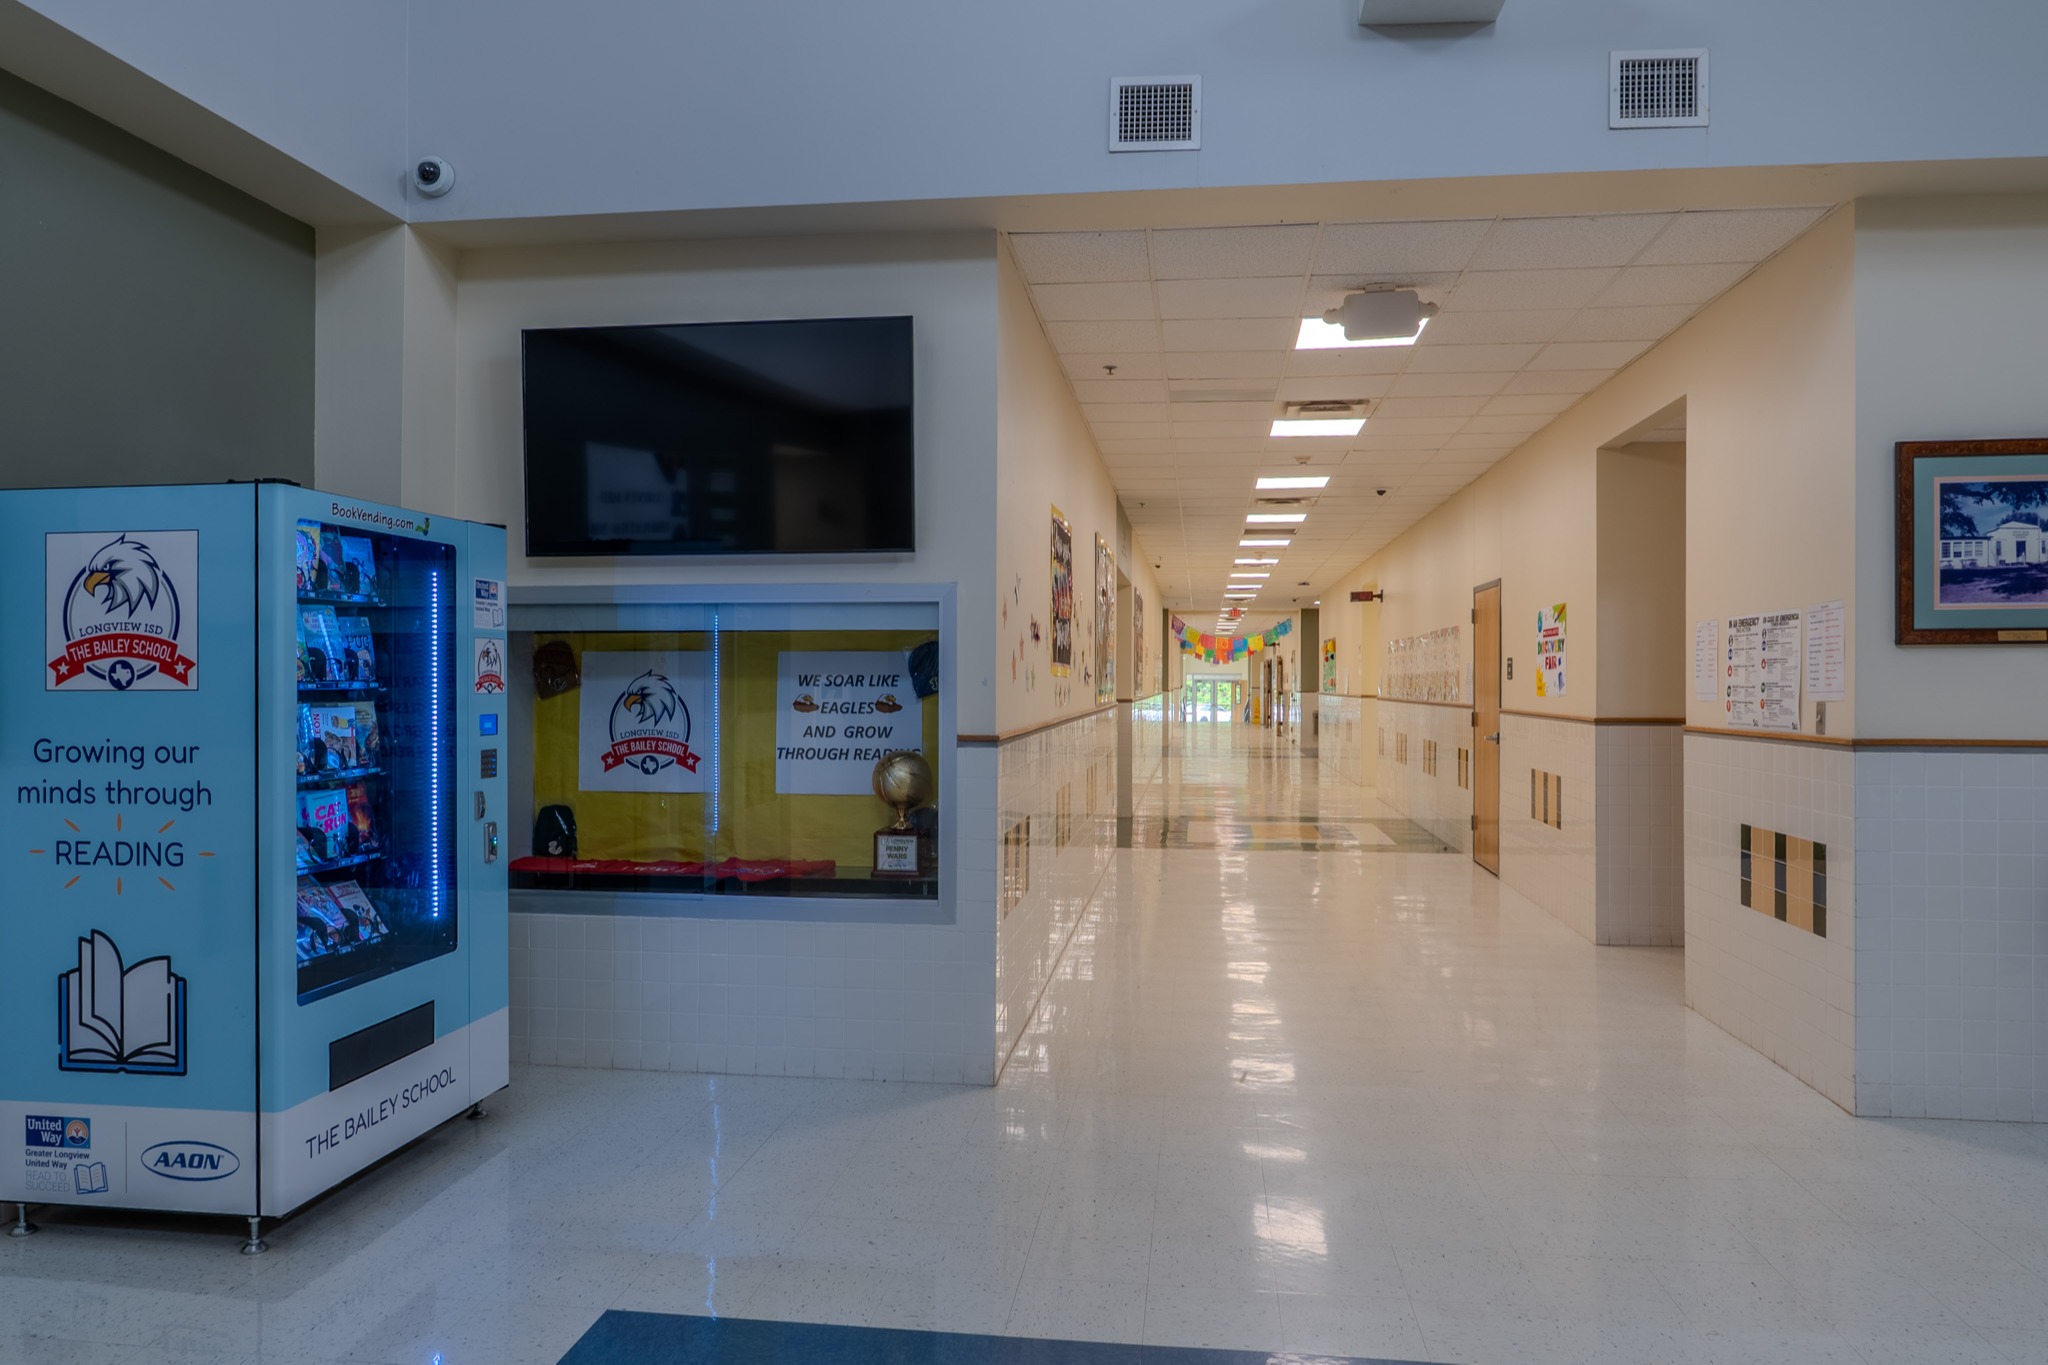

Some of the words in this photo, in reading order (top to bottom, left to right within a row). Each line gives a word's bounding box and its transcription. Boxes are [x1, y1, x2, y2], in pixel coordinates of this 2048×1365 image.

[332, 503, 414, 530] BookVending.com
[1738, 616, 1760, 628] EMERGENCY
[79, 622, 142, 638] LONGVIEW
[144, 624, 164, 636] ISD
[70, 644, 91, 662] THE
[93, 638, 130, 655] BAILEY
[132, 639, 173, 662] SCHOOL
[1545, 656, 1557, 670] FAIR
[798, 674, 822, 687] WE
[824, 674, 865, 687] SOAR
[868, 674, 900, 687] LIKE
[820, 702, 875, 714] EAGLES
[620, 729, 664, 739] LONGVIEW
[666, 731, 680, 739] ISD
[802, 726, 836, 738] AND
[844, 726, 894, 738] GROW
[33, 738, 145, 770] Growing
[154, 745, 200, 764] our
[614, 744, 630, 756] THE
[630, 740, 656, 752] BAILEY
[658, 741, 685, 756] SCHOOL
[776, 747, 849, 760] THROUGH
[18, 779, 96, 804] minds
[105, 780, 212, 812] through
[324, 812, 347, 834] RUN
[56, 840, 184, 867] READING
[305, 1124, 340, 1159] THE
[344, 1093, 398, 1140] BAILEY
[402, 1066, 457, 1109] SCHOOL
[27, 1118, 62, 1131] United
[40, 1131, 62, 1146] Way
[26, 1149, 52, 1158] Greater
[54, 1150, 90, 1160] Longview
[153, 1152, 222, 1170] AAON
[26, 1158, 50, 1168] United
[52, 1160, 68, 1170] Way
[26, 1170, 52, 1181] READ
[53, 1172, 66, 1182] TO
[26, 1180, 70, 1192] SUCCEED
